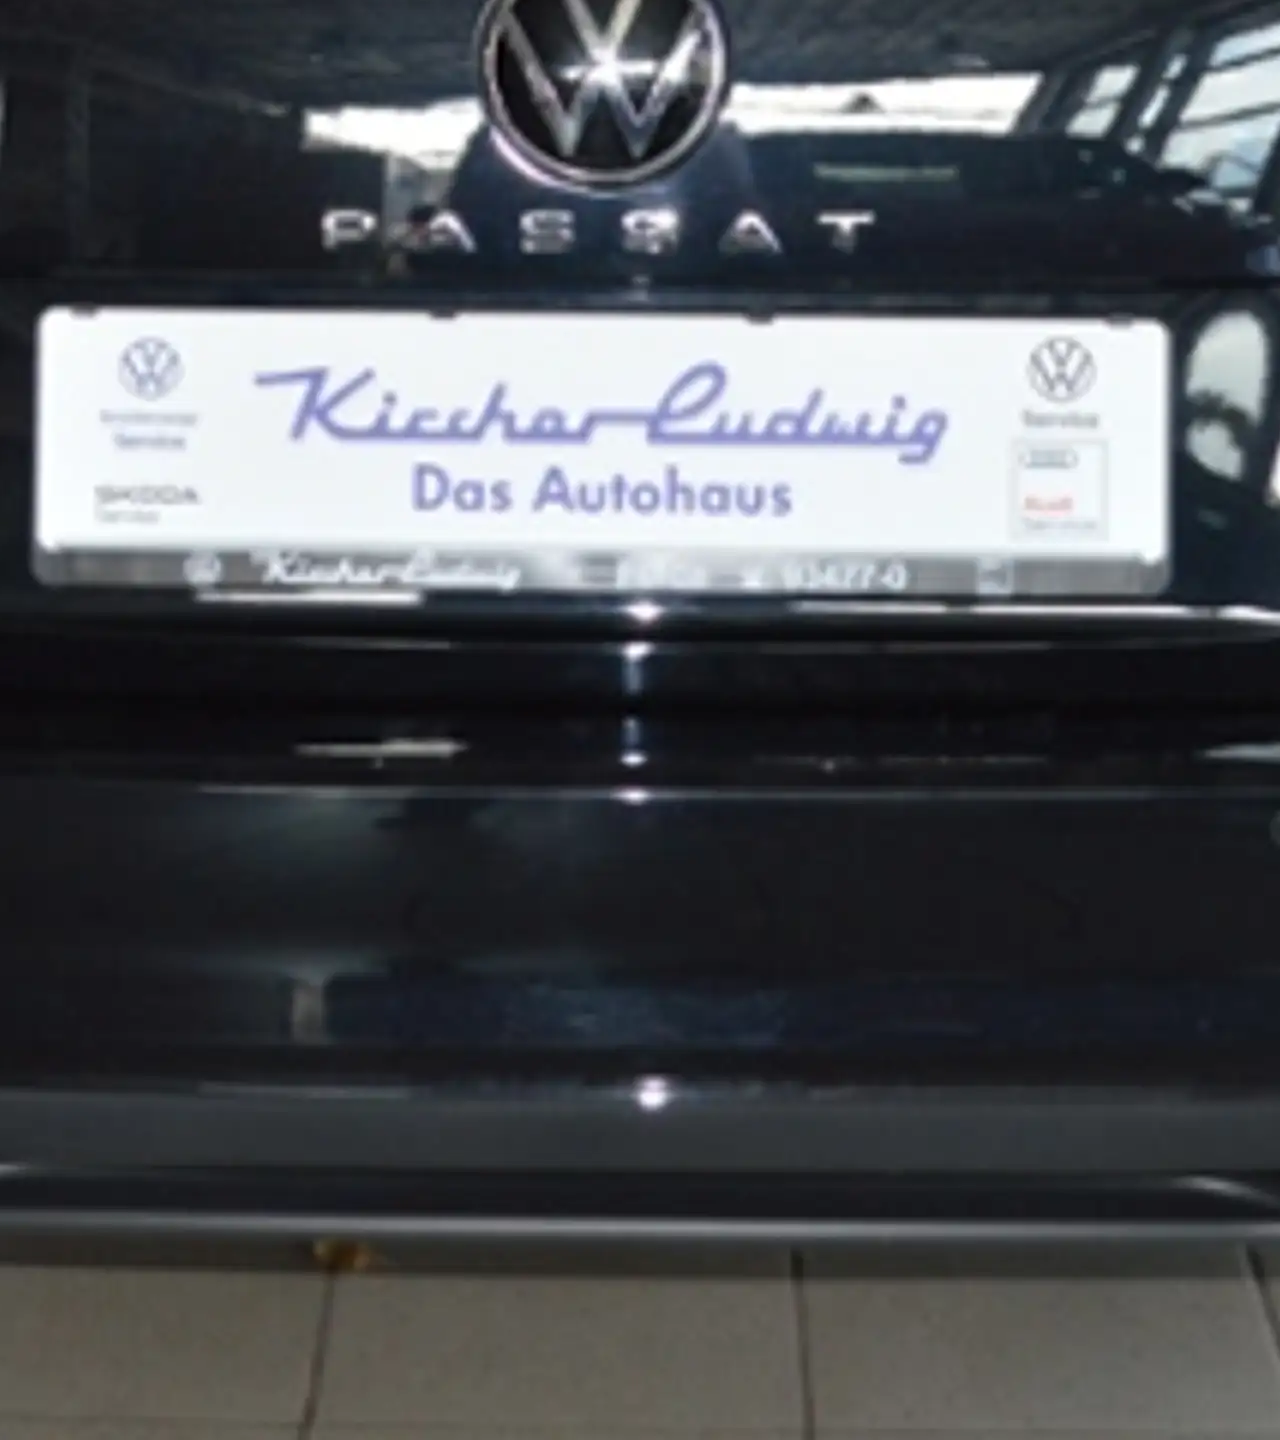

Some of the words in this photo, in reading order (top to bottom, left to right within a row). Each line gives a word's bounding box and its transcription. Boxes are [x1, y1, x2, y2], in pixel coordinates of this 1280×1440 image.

[320, 209, 876, 255] PASSAT
[410, 461, 513, 513] Das
[532, 462, 794, 517] Autohaus
